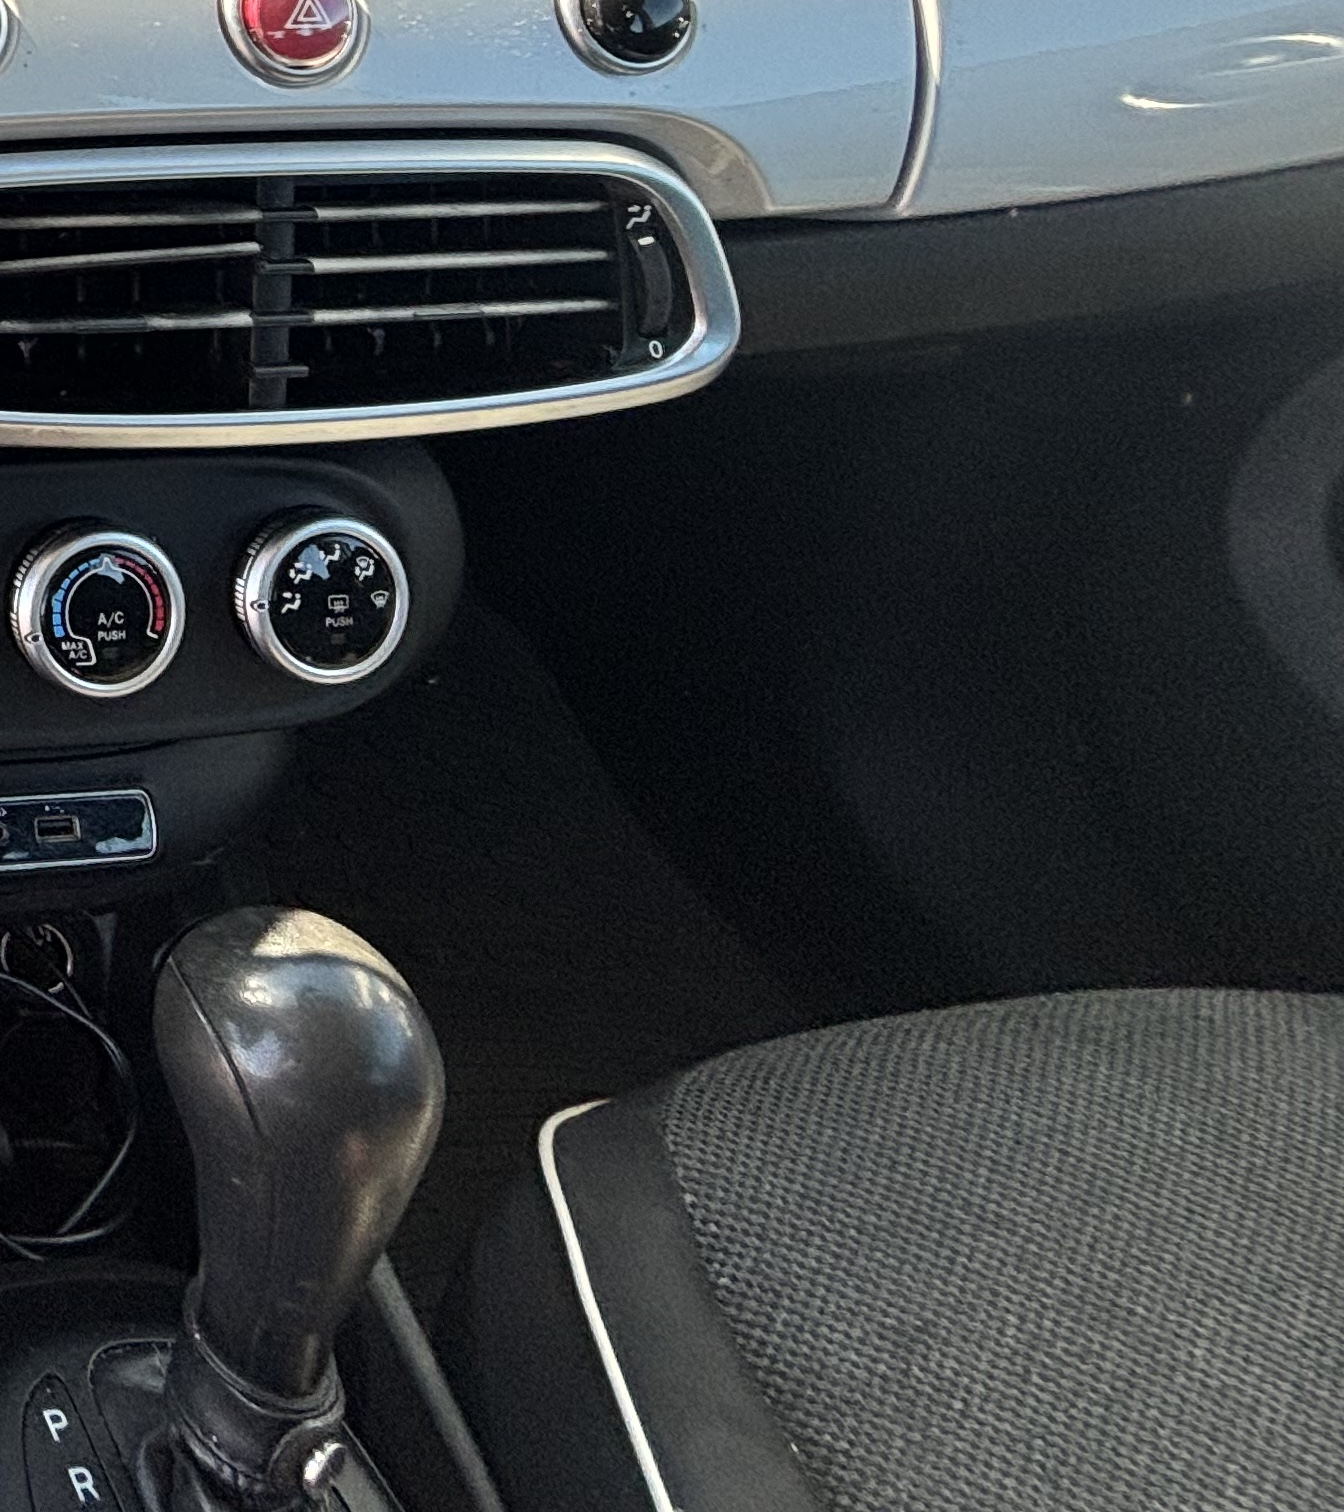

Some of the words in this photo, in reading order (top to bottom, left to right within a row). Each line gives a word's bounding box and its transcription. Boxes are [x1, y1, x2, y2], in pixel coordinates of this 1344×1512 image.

[97, 611, 125, 628] A/C
[325, 616, 354, 628] PUSH
[97, 630, 126, 642] PUSH
[62, 641, 84, 651] MAX
[68, 650, 88, 660] A/C
[42, 1408, 69, 1444] P
[67, 1465, 101, 1502] R
